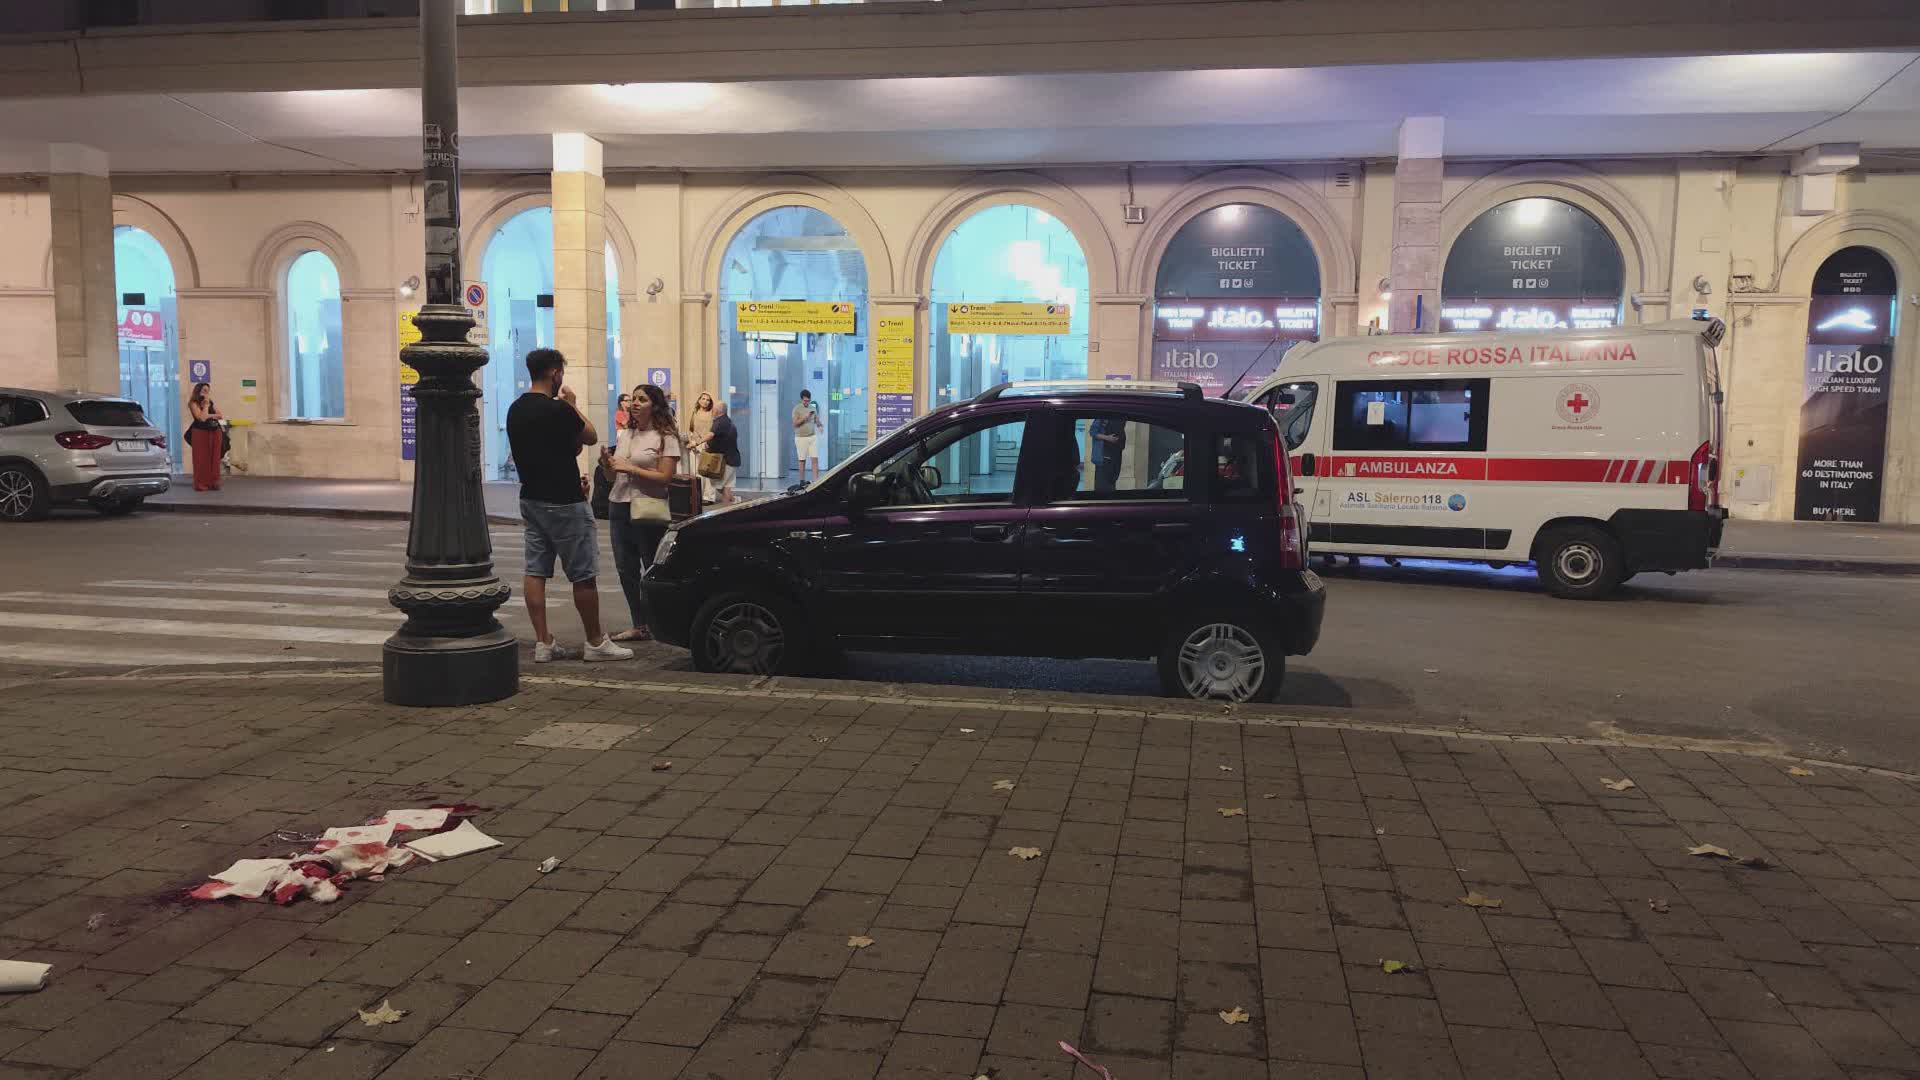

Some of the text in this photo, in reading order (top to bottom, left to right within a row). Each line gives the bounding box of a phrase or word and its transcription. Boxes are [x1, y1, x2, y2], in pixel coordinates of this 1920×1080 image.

[1211, 247, 1265, 257] BIGLIETTI
[1503, 246, 1561, 256] BIGLIETTI
[1217, 260, 1257, 270] TICKET
[1510, 260, 1553, 270] TICKET
[1447, 347, 1523, 365] ROSSA
[1815, 376, 1844, 384] ITALIAN
[1809, 385, 1881, 394] HIGH SPEED TRAIN
[1359, 461, 1458, 475] AMBULANZA
[1813, 459, 1864, 469] MORE THAN
[1802, 470, 1874, 479] 60 DESTINATIONS
[1820, 480, 1854, 489] IN ITALY
[1347, 491, 1442, 504] ASL Salerno 118
[1812, 507, 1857, 516] BUY HERE
